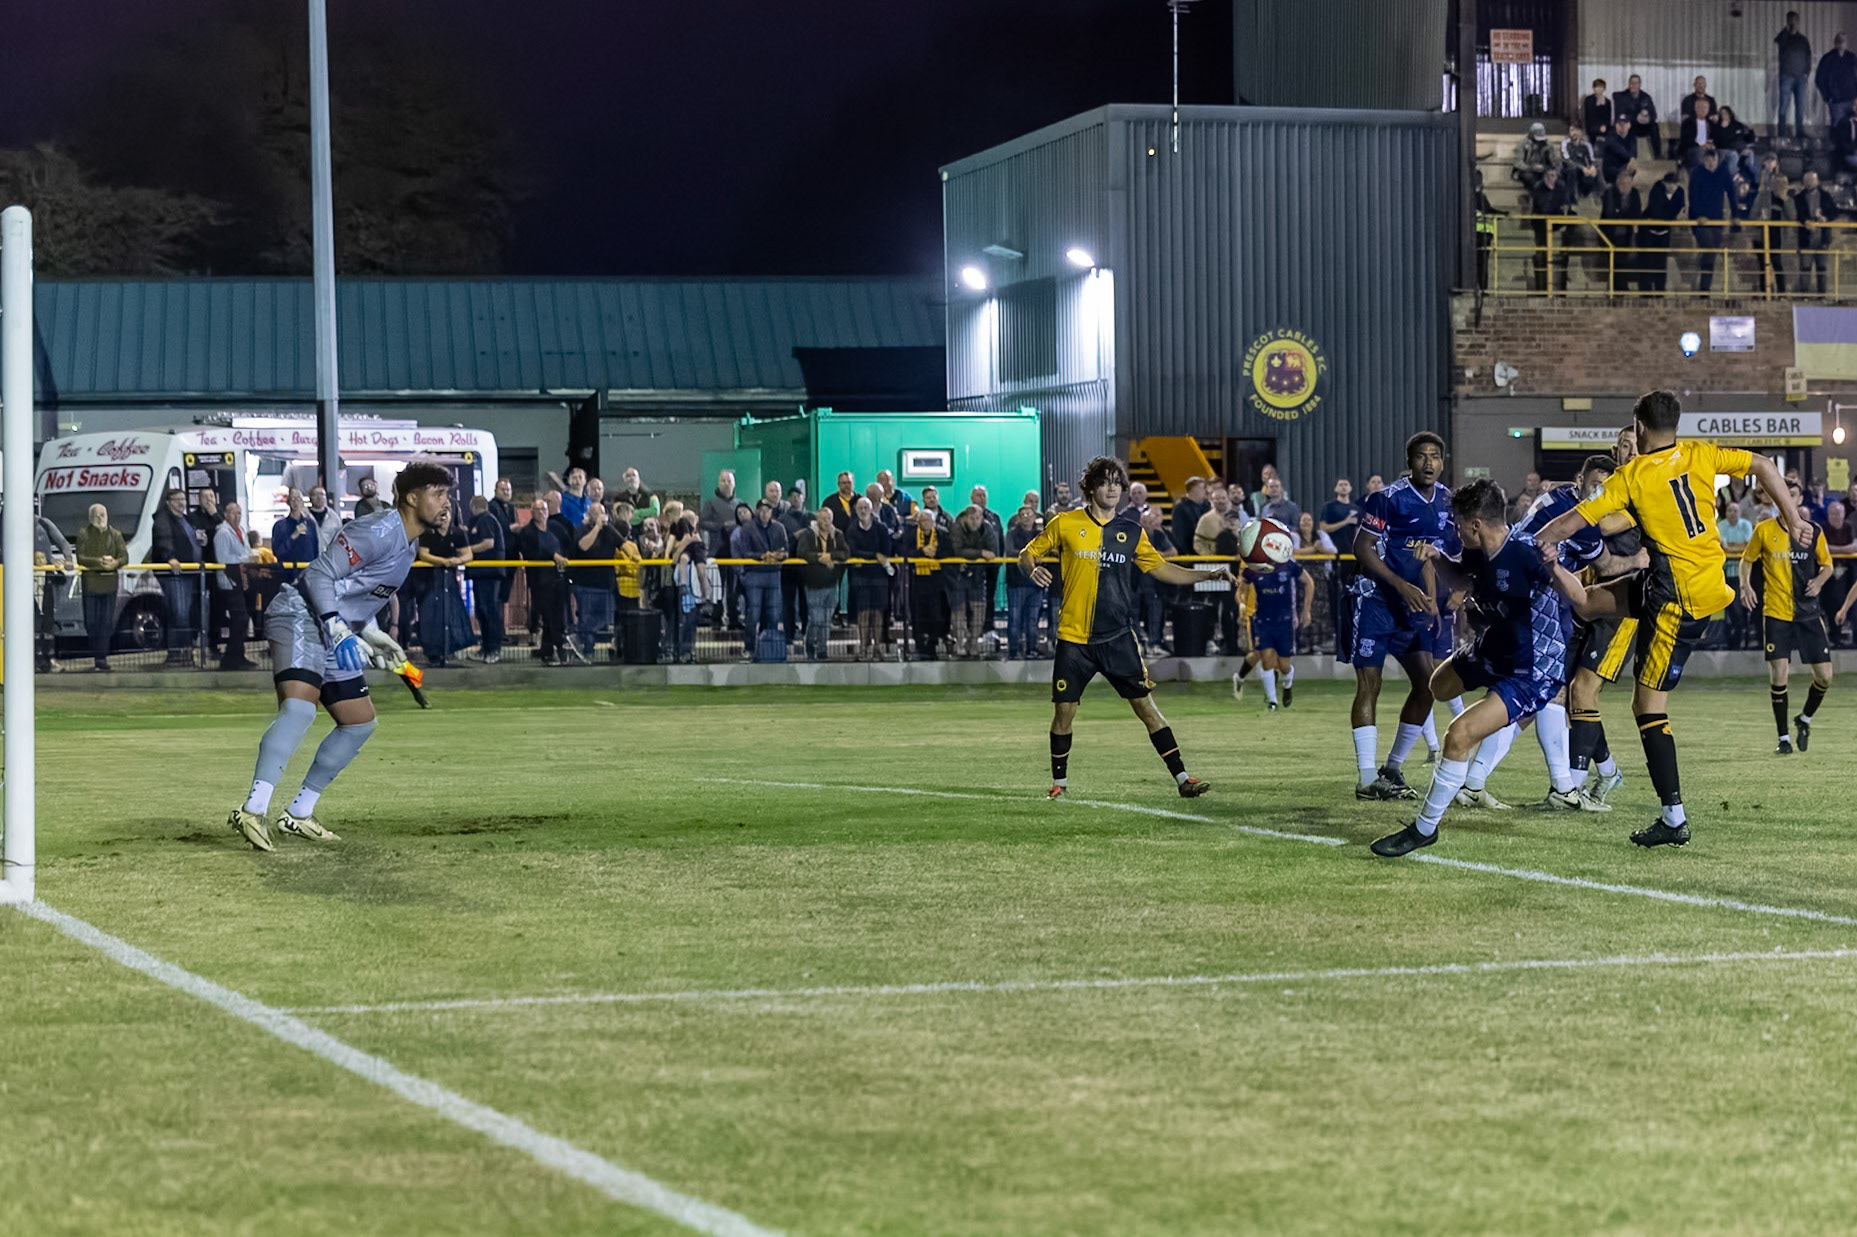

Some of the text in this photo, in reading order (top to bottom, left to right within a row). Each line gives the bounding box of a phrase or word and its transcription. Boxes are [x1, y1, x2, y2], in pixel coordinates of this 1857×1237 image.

[1242, 328, 1327, 376] PRESCOT CABLES FC
[1249, 393, 1299, 420] FOUNDED
[1568, 430, 1600, 439] SNACK
[1697, 418, 1801, 433] CABLES BAR
[56, 437, 150, 461] Tea Coffee
[196, 431, 217, 445] Tea
[233, 431, 276, 447] Coffee
[350, 431, 368, 446] Hot
[371, 432, 399, 447] Dogs
[413, 432, 445, 446] Bacon
[450, 432, 478, 446] Rolls
[44, 467, 141, 490] No1 Snacks
[1669, 473, 1706, 539] 11
[1074, 549, 1126, 564] MERMAID
